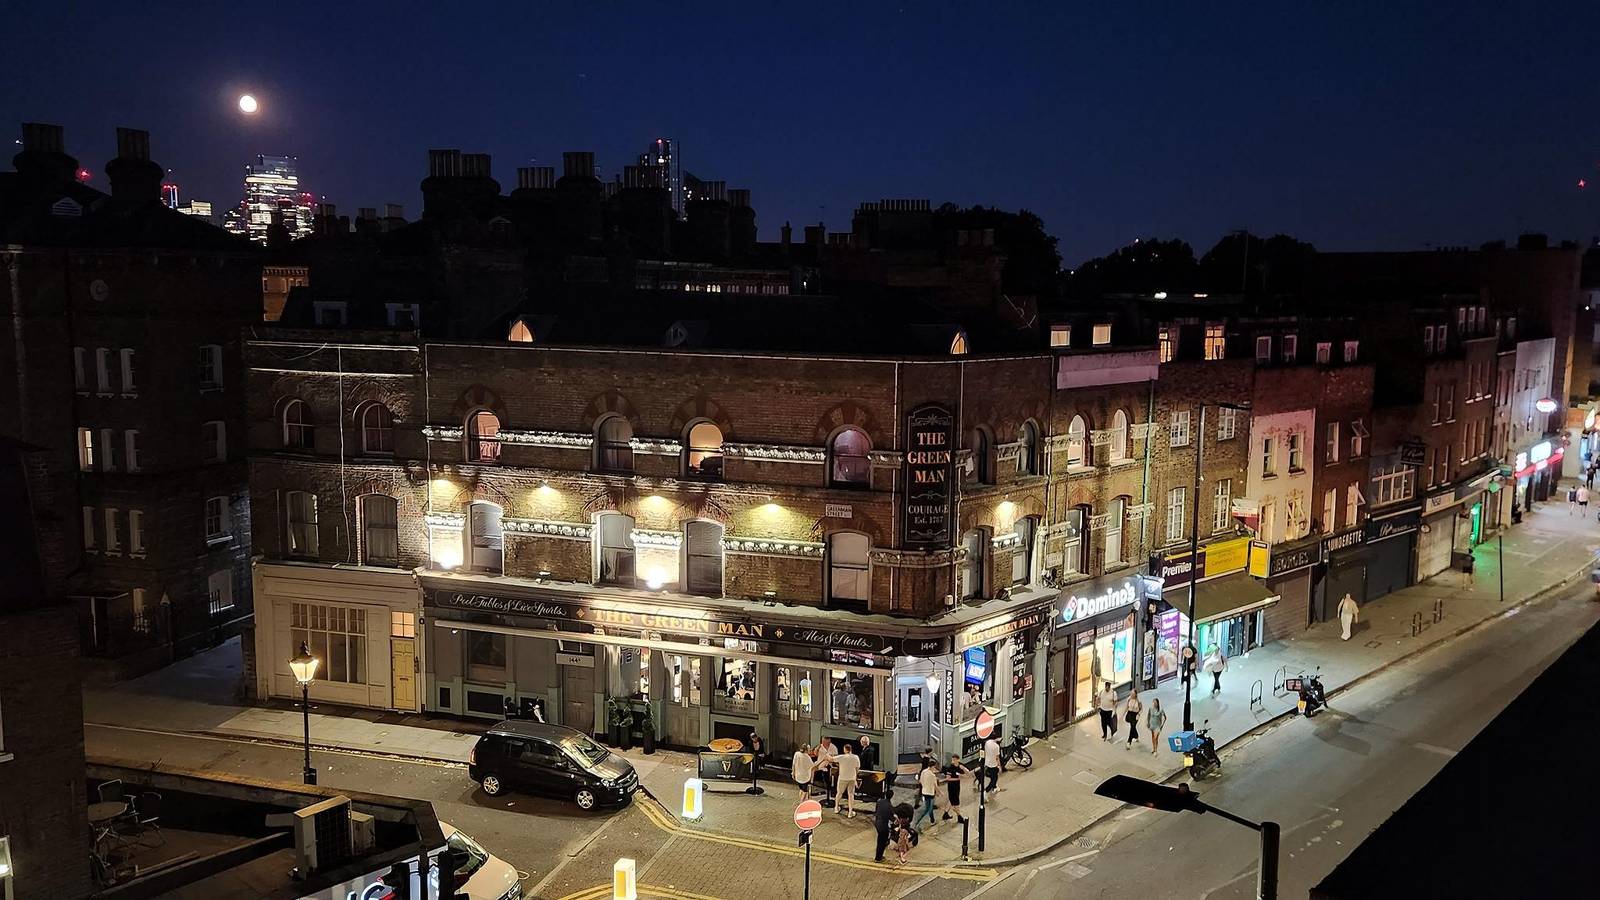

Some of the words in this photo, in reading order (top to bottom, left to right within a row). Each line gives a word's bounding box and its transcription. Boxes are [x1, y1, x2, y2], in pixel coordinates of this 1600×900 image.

[917, 432, 945, 445] THE
[907, 450, 951, 464] GREEN
[915, 470, 945, 483] MAN
[908, 504, 949, 515] COURAGE
[1162, 562, 1192, 577] Premier
[1076, 582, 1136, 619] Domino's
[531, 601, 567, 616] Sports
[594, 609, 634, 625] THE
[641, 614, 710, 633] GREEN
[717, 622, 763, 638] MAN
[986, 622, 1018, 638] GREEN
[1019, 615, 1039, 628] MAN
[832, 633, 873, 648] Stouts
